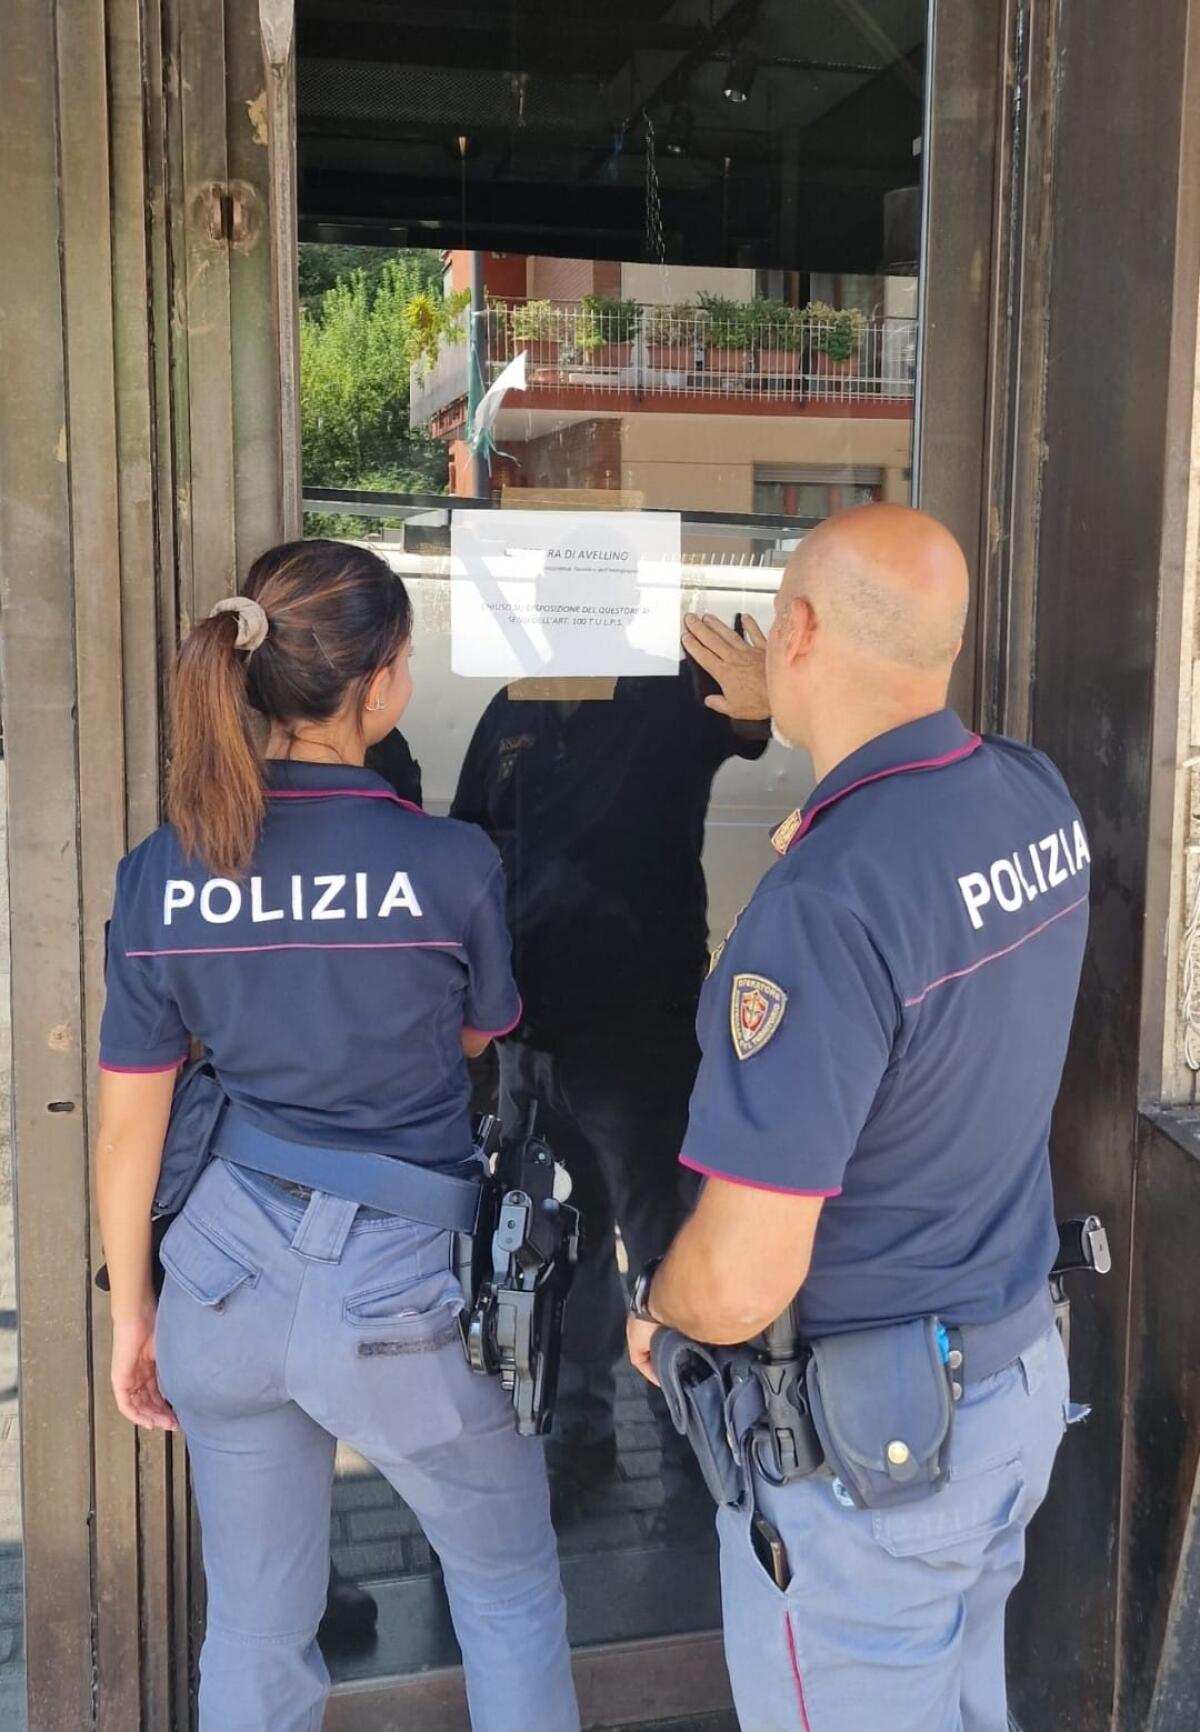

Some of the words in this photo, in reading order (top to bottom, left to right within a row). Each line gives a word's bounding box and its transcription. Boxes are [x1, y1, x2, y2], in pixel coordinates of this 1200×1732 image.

[565, 549, 576, 559] DI
[577, 550, 629, 561] AVELLINO
[582, 605, 596, 614] DEL
[572, 617, 587, 626] 100
[957, 820, 1092, 930] POLIZIA
[163, 871, 423, 925] POLIZIA
